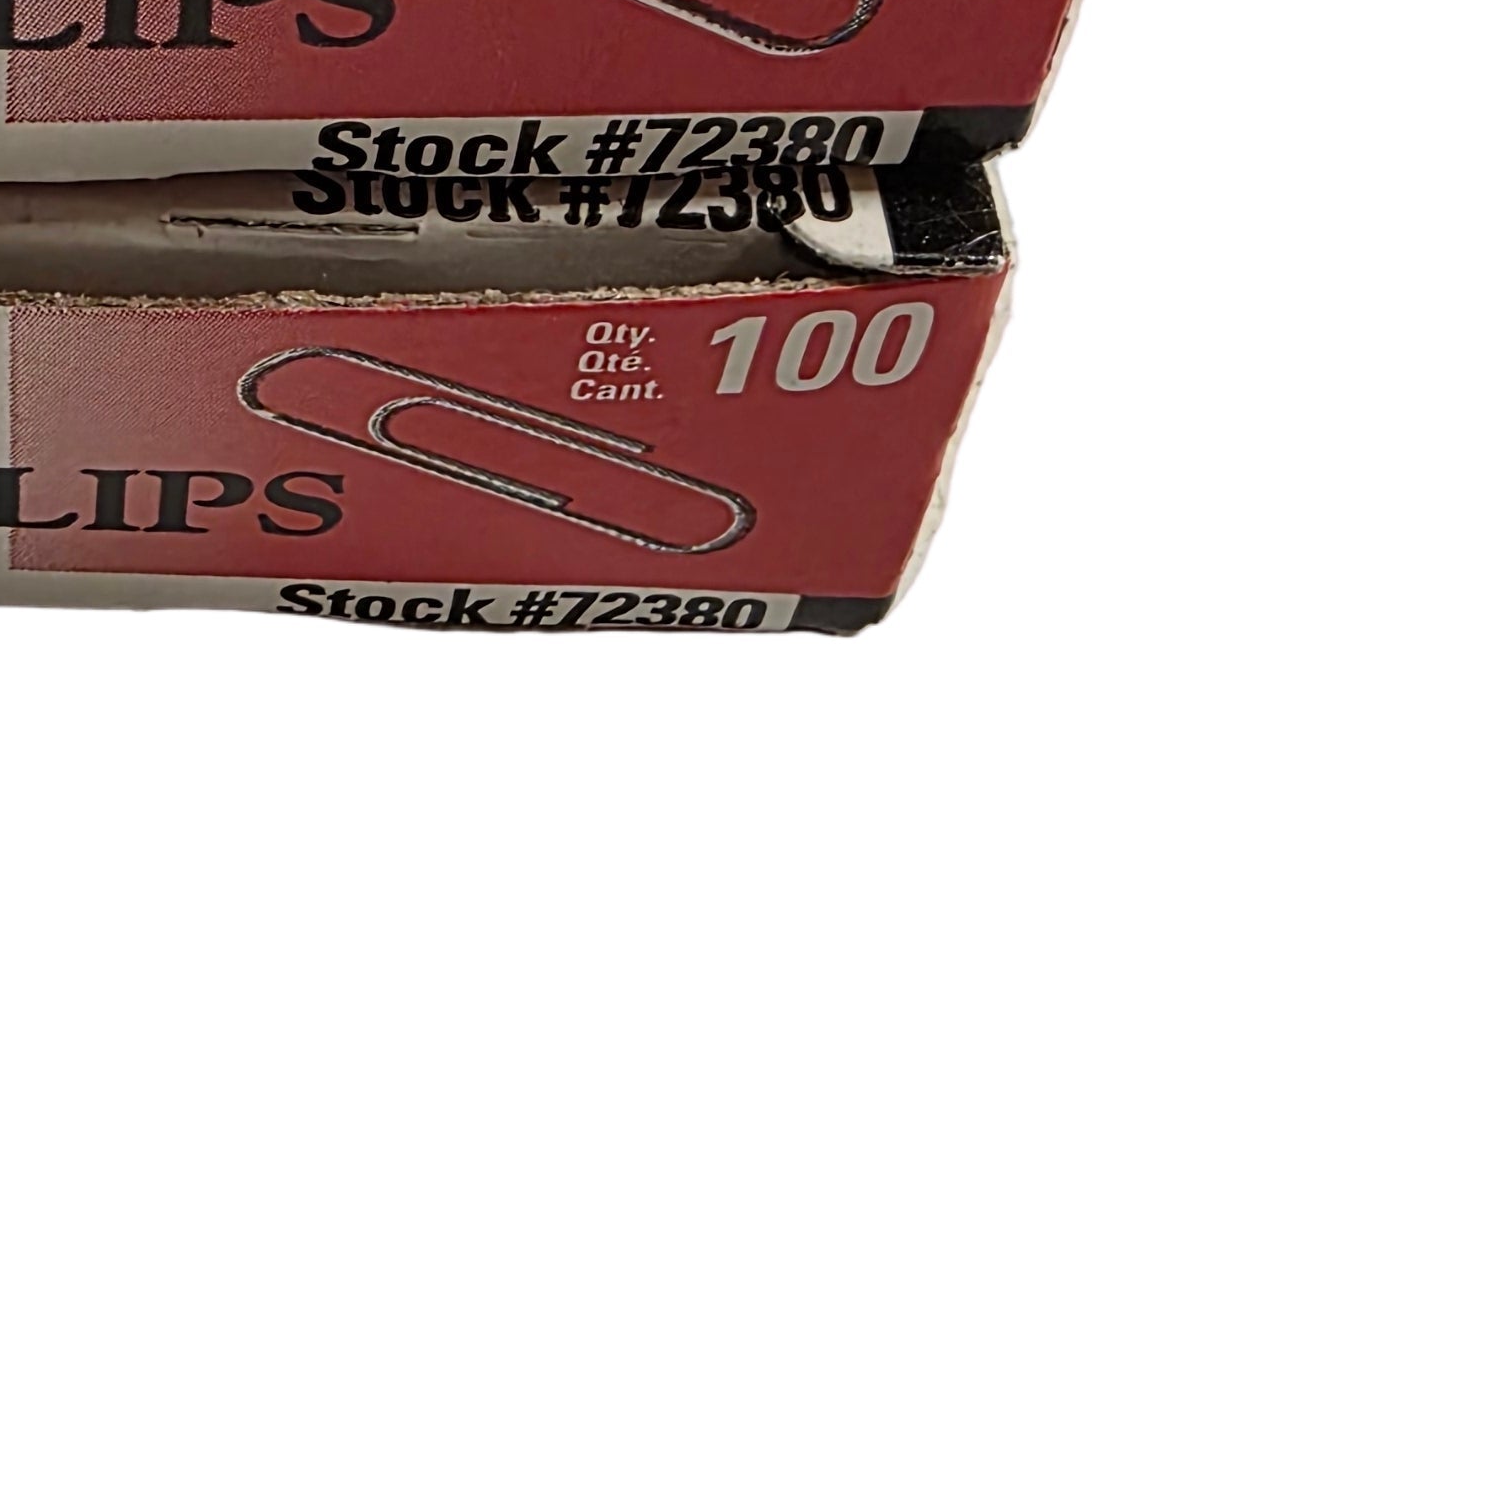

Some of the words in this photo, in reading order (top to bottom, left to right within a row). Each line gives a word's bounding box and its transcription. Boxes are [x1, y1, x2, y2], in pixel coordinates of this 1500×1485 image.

[311, 119, 569, 176] Stock
[584, 115, 885, 174] #72380
[291, 168, 541, 223] Stock
[585, 321, 657, 346] Qty.
[709, 301, 935, 395] 100
[578, 348, 651, 373] Qté.
[569, 377, 665, 402] Cant.
[276, 582, 498, 627] Stock
[509, 590, 768, 630] #72380
